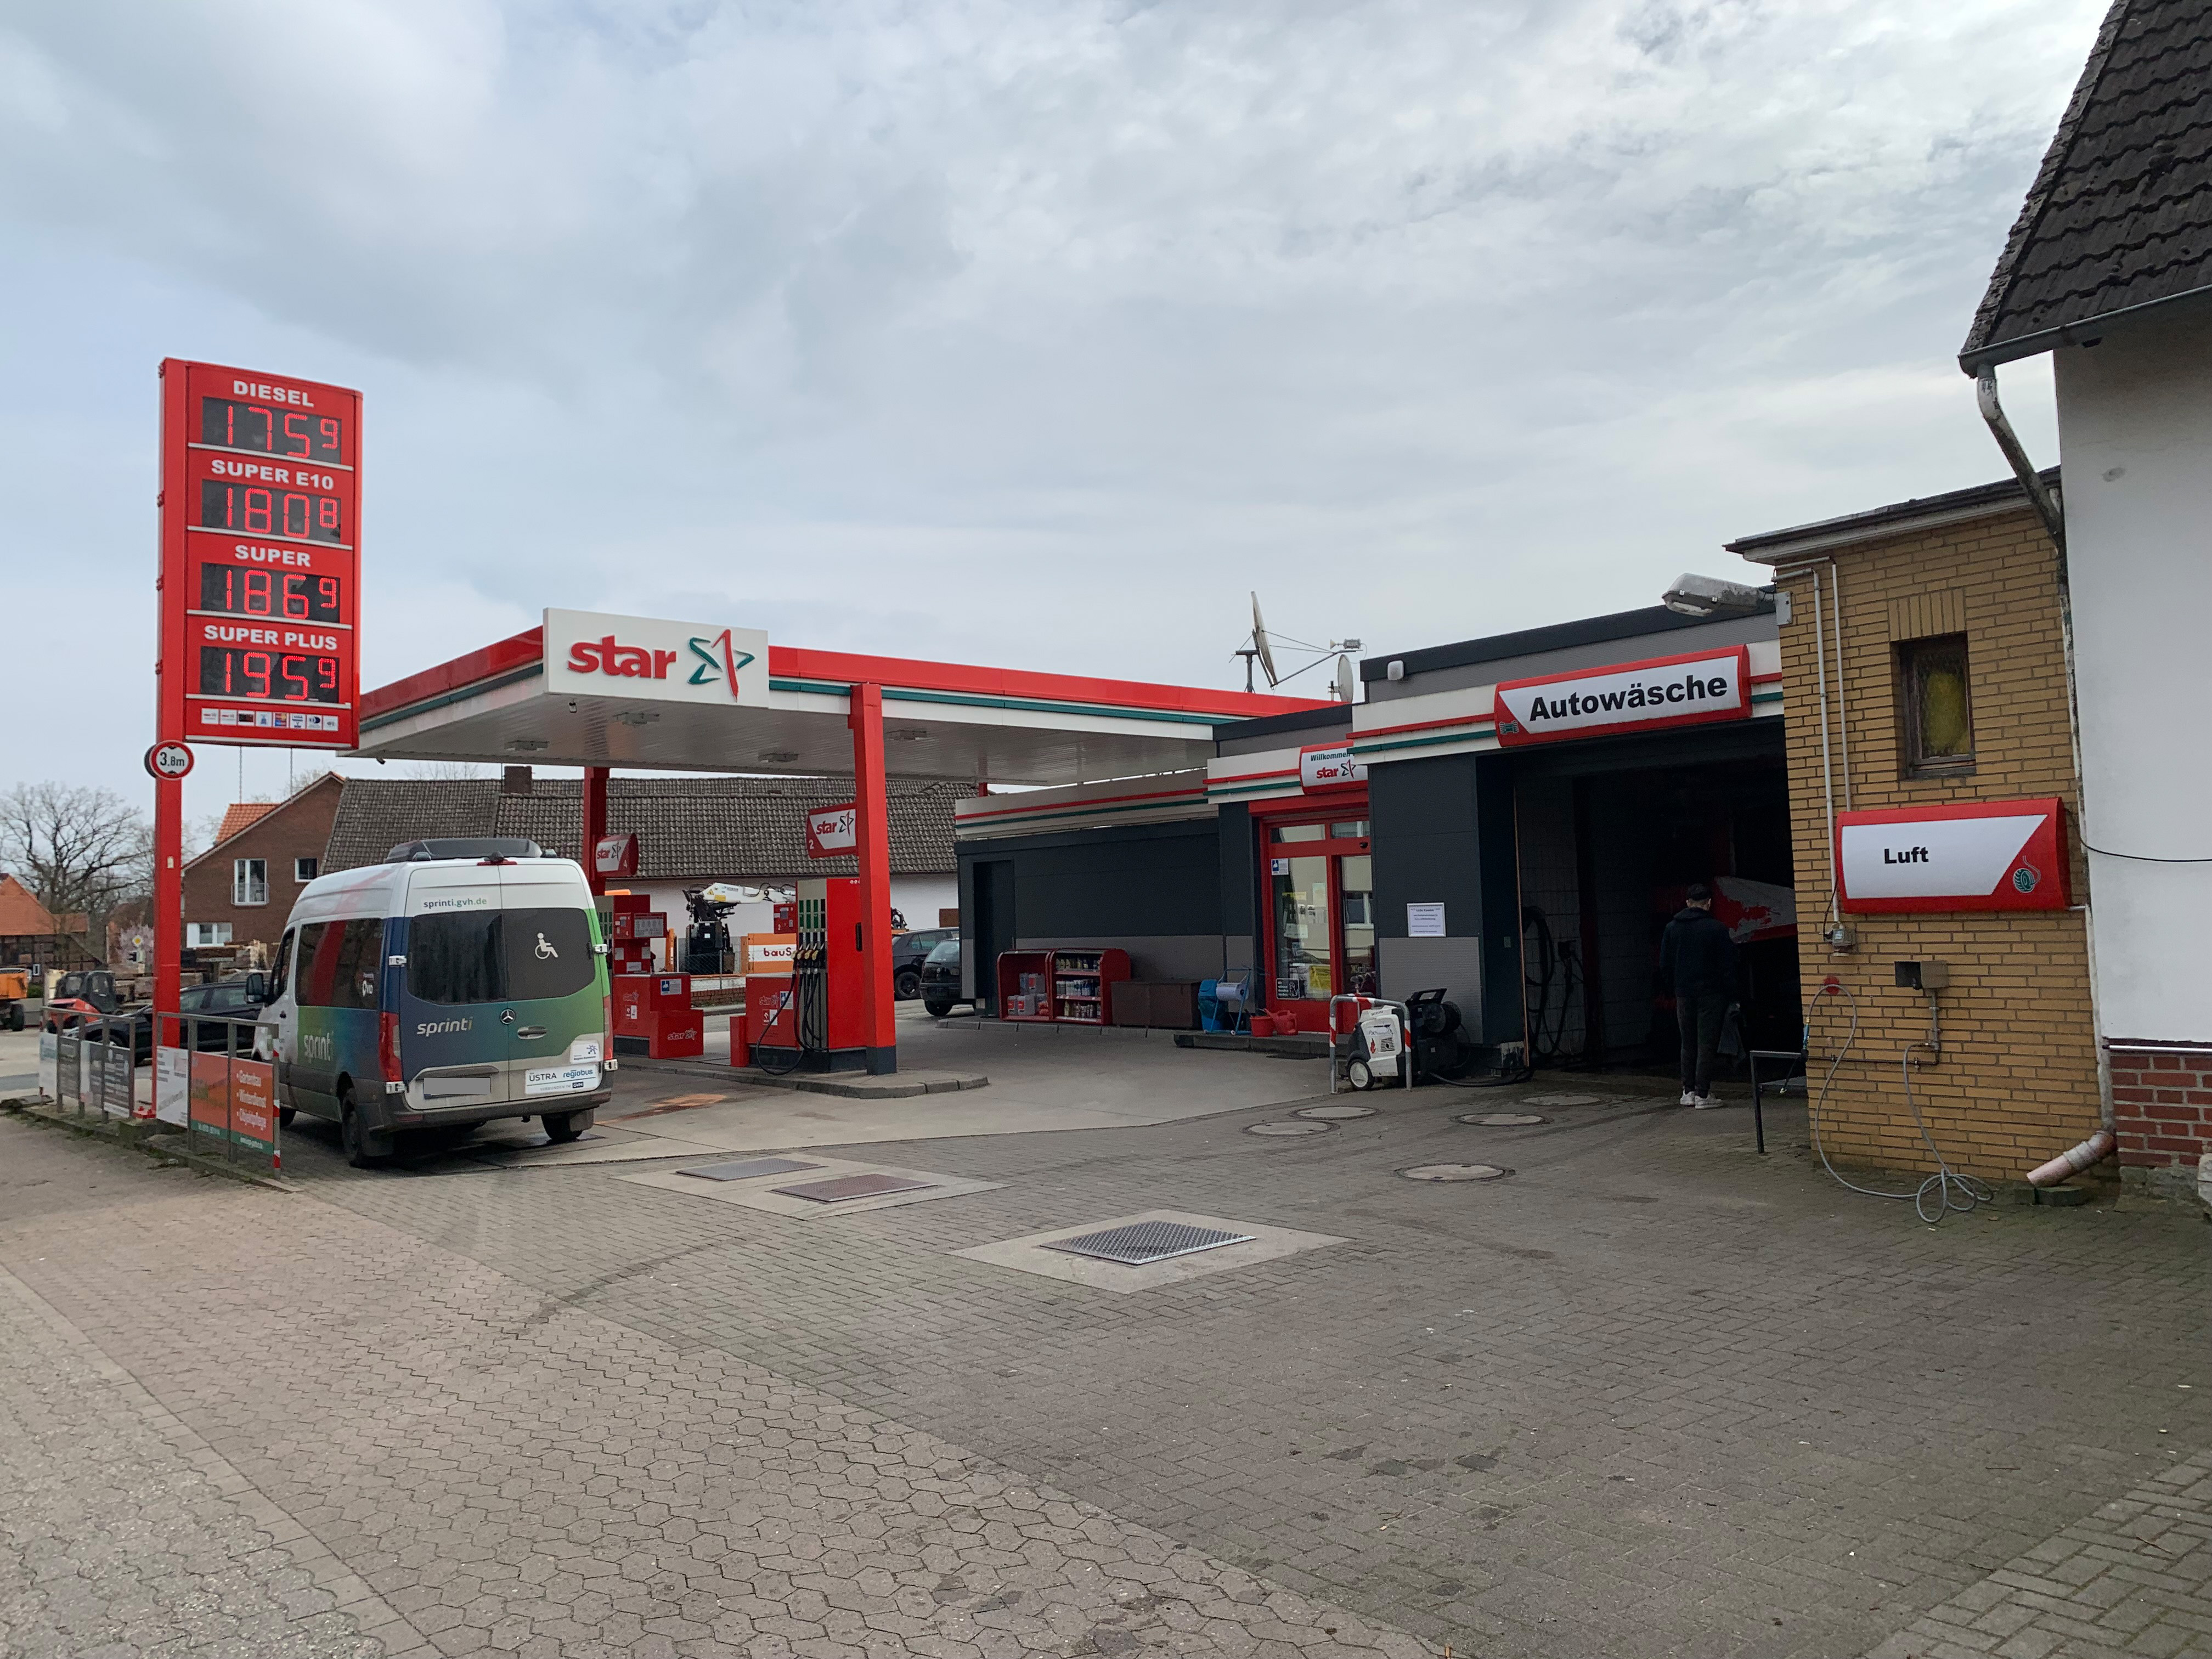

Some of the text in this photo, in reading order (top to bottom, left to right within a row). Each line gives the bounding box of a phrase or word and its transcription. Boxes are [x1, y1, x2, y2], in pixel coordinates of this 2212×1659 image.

[233, 380, 314, 407] DIESEL
[211, 459, 334, 490] SUPER E10
[235, 545, 311, 567] SUPER
[204, 624, 337, 651] SUPER PLUS
[567, 634, 677, 680] star
[1529, 674, 1728, 721] Autowäsche
[1316, 766, 1339, 779] star
[816, 820, 838, 835] star
[808, 839, 815, 849] 2
[597, 849, 611, 860] star
[1884, 846, 1929, 864] Luft
[423, 898, 487, 910] sprinti.gvh.de
[416, 1016, 473, 1037] sprinti
[667, 1032, 685, 1041] star
[563, 1069, 593, 1079] regiobus
